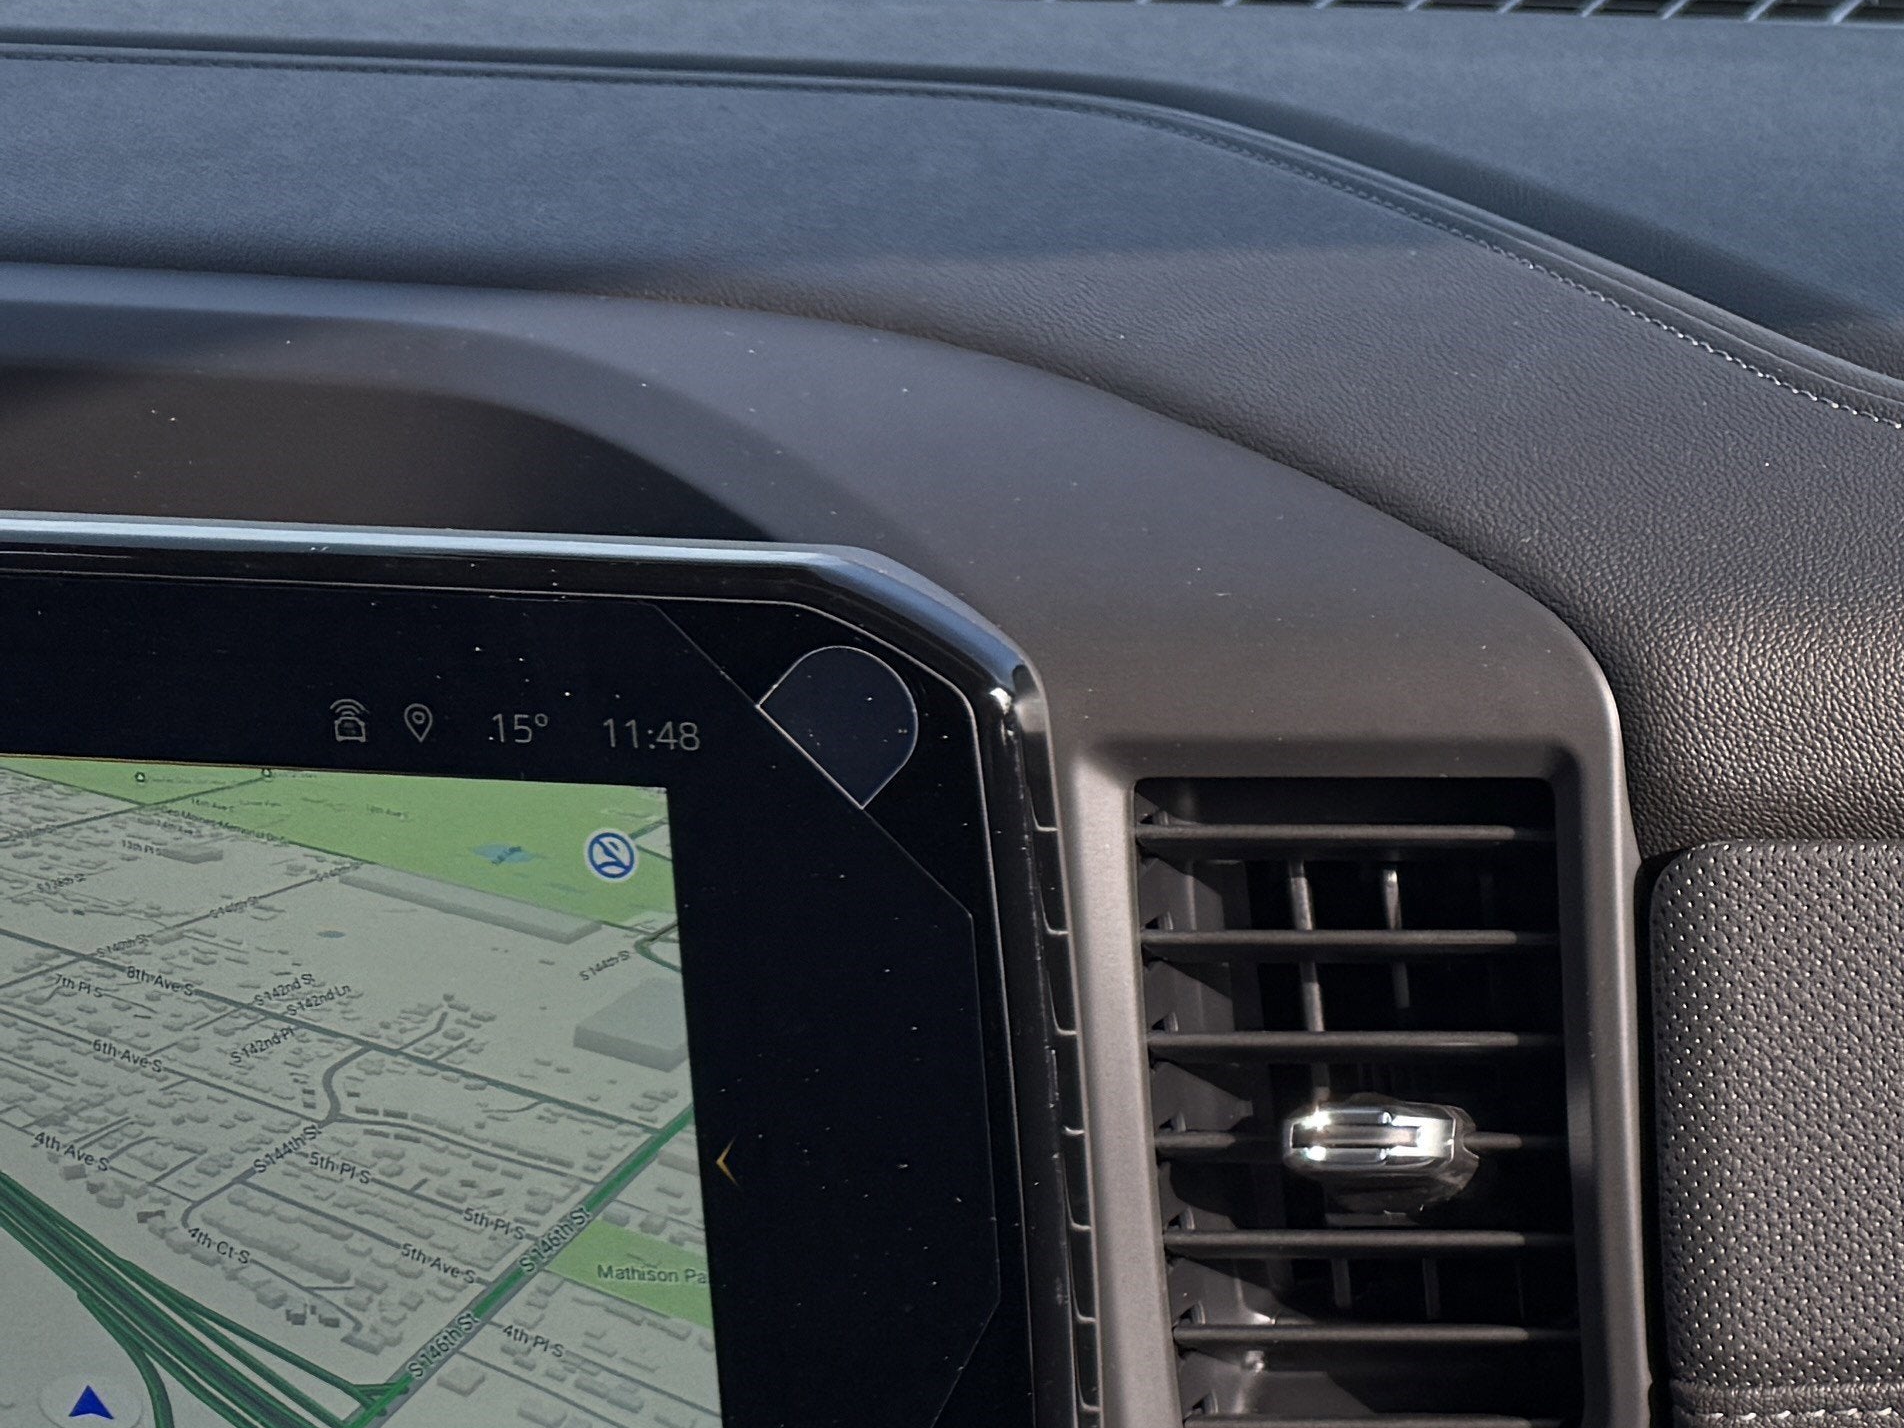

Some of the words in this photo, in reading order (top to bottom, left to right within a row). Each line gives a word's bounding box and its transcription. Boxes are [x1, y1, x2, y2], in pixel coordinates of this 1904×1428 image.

[603, 718, 700, 751] 11:48
[55, 973, 74, 989] 7th
[78, 981, 91, 994] Pl
[93, 986, 104, 998] S
[127, 966, 150, 983] 8th
[154, 976, 178, 992] Ave
[183, 983, 194, 996] S
[254, 993, 264, 1006] S
[265, 977, 301, 1000] 142nd
[301, 972, 316, 986] St
[286, 1004, 297, 1016] S
[298, 988, 334, 1010] 142nd
[334, 984, 351, 997] Ln
[93, 1039, 116, 1057] 6th
[121, 1050, 148, 1068] Ave
[152, 1059, 163, 1073] S
[230, 1051, 242, 1064] S
[243, 1032, 281, 1057] 142nd
[280, 1027, 295, 1040] Pl
[34, 1132, 60, 1152] 4th
[64, 1144, 94, 1166] Ave
[98, 1156, 110, 1172] S
[253, 1158, 267, 1174] S
[265, 1134, 305, 1165] 144th
[303, 1123, 322, 1141] St
[308, 1151, 335, 1173] 5th
[339, 1162, 357, 1179] Pl
[359, 1169, 372, 1185] S
[463, 1208, 491, 1229] 5th
[494, 1218, 510, 1235] Pl
[514, 1225, 527, 1241] S
[520, 1254, 536, 1272] S
[535, 1221, 573, 1259] 146th
[571, 1206, 592, 1226] St
[188, 1226, 212, 1250] 4th
[216, 1240, 235, 1258] Ct
[238, 1250, 251, 1265] S
[401, 1243, 427, 1264] 5th
[430, 1258, 460, 1278] Ave
[463, 1269, 477, 1285] S
[597, 1265, 679, 1283] Mathison
[409, 1360, 425, 1378] S
[423, 1327, 461, 1365] 146th
[458, 1312, 479, 1331] St
[503, 1325, 530, 1346] 4th
[533, 1335, 550, 1352] Pl
[552, 1341, 565, 1358] S
